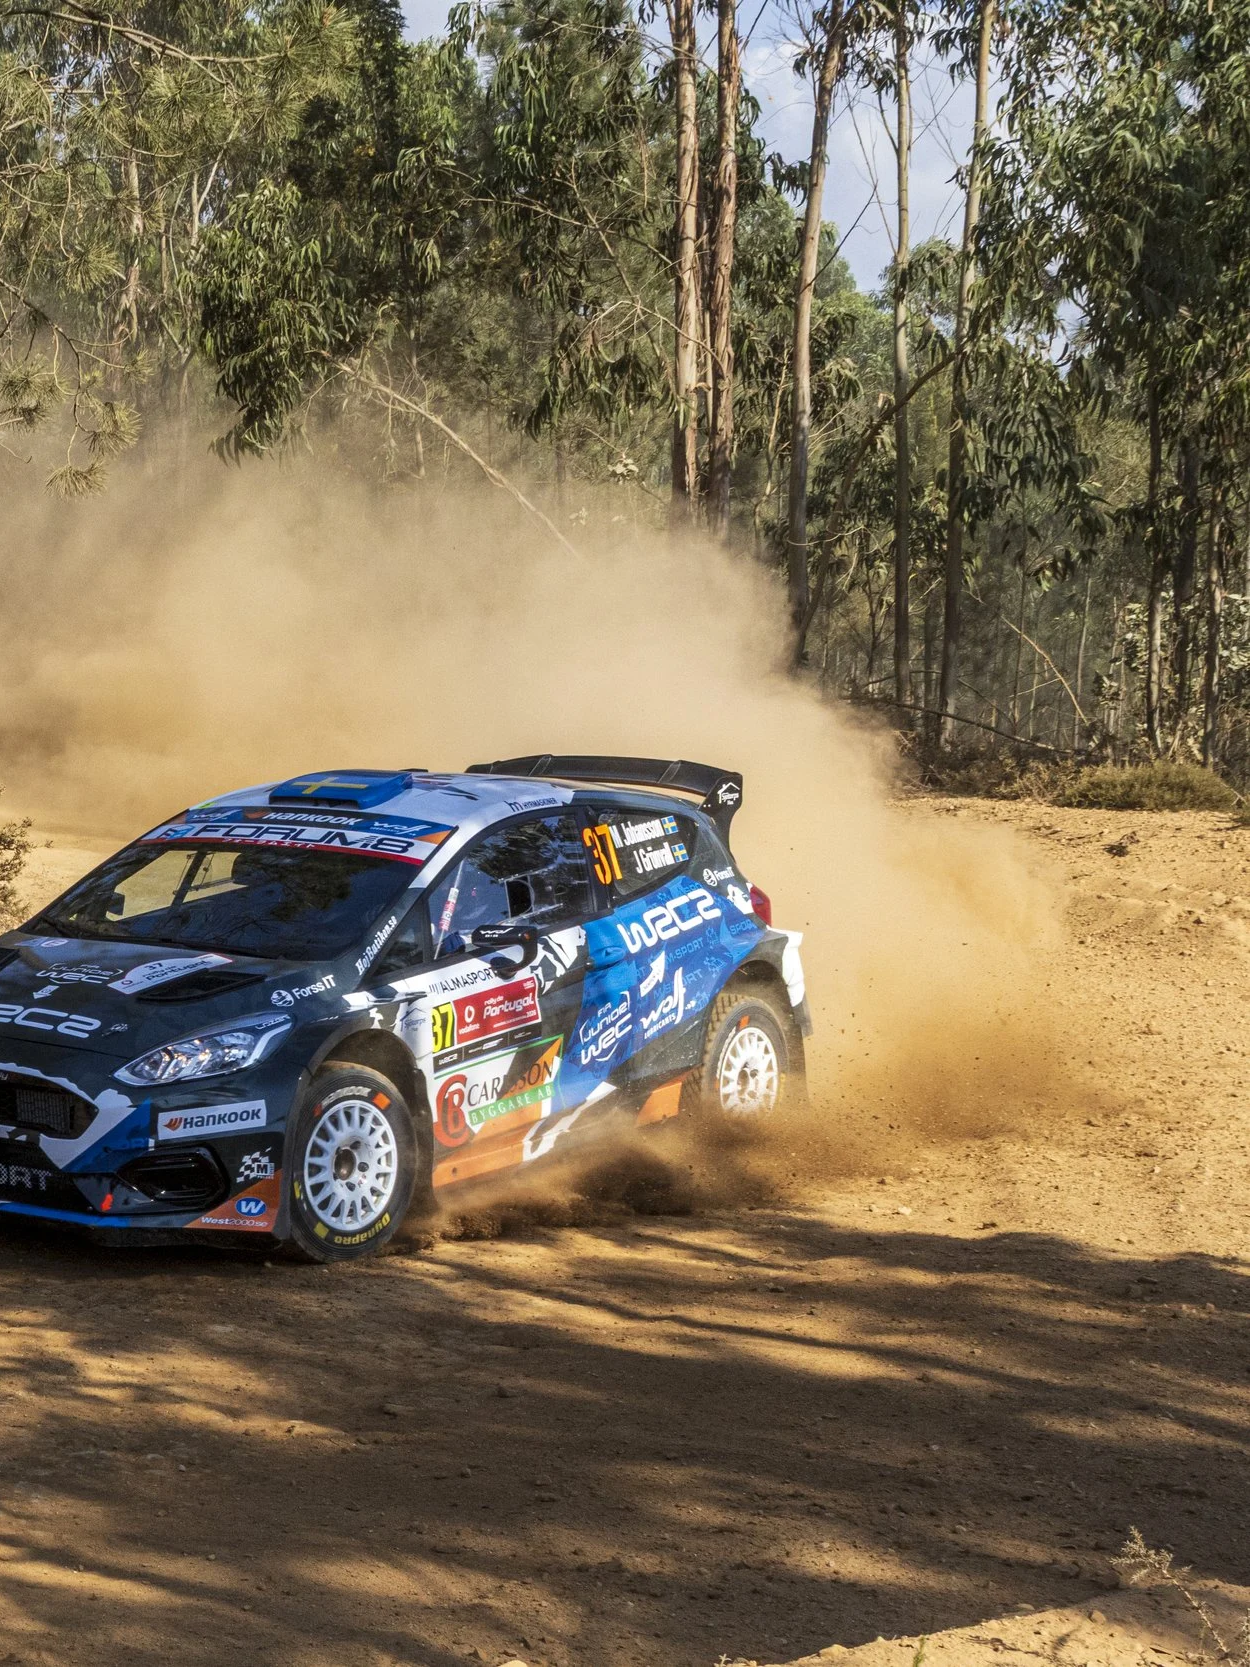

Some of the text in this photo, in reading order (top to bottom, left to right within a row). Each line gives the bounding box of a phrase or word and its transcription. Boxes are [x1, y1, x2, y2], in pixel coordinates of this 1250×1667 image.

[621, 819, 665, 846] Johansson
[582, 823, 623, 886] 37
[633, 849, 644, 874] J
[616, 887, 722, 954] WRC2
[483, 993, 535, 1020] Portugal
[583, 1003, 630, 1041] JUNIOR
[598, 1003, 612, 1017] FIA
[432, 1001, 454, 1054] 37
[581, 1012, 633, 1065] WRC
[643, 1012, 677, 1040] LUBRICANTS
[471, 1085, 552, 1125] BYGGARE AB
